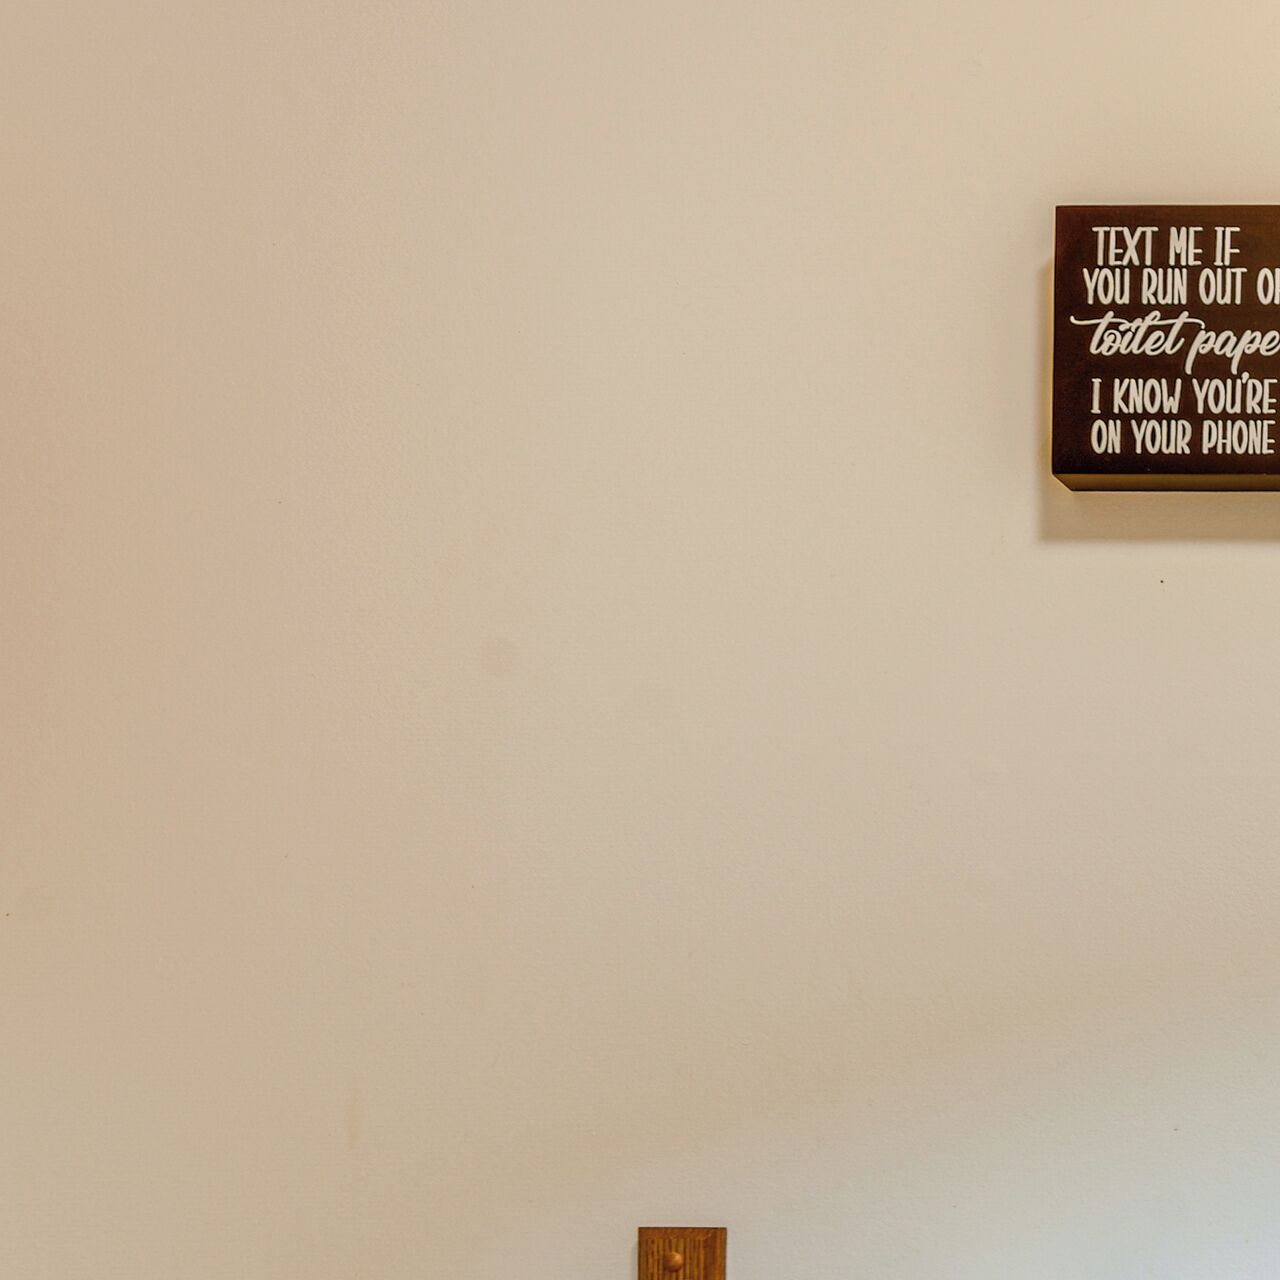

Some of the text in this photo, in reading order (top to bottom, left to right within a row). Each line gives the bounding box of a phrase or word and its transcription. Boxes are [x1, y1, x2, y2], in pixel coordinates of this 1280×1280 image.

[1092, 226, 1241, 266] TEXT ME IF
[1083, 268, 1130, 305] YOU
[1141, 268, 1187, 305] RUN
[1199, 268, 1247, 305] OUT
[1070, 310, 1205, 356] toilet
[1091, 371, 1278, 414] I KNOW YOU'RE
[1091, 420, 1276, 454] ON YOUR PHONE
